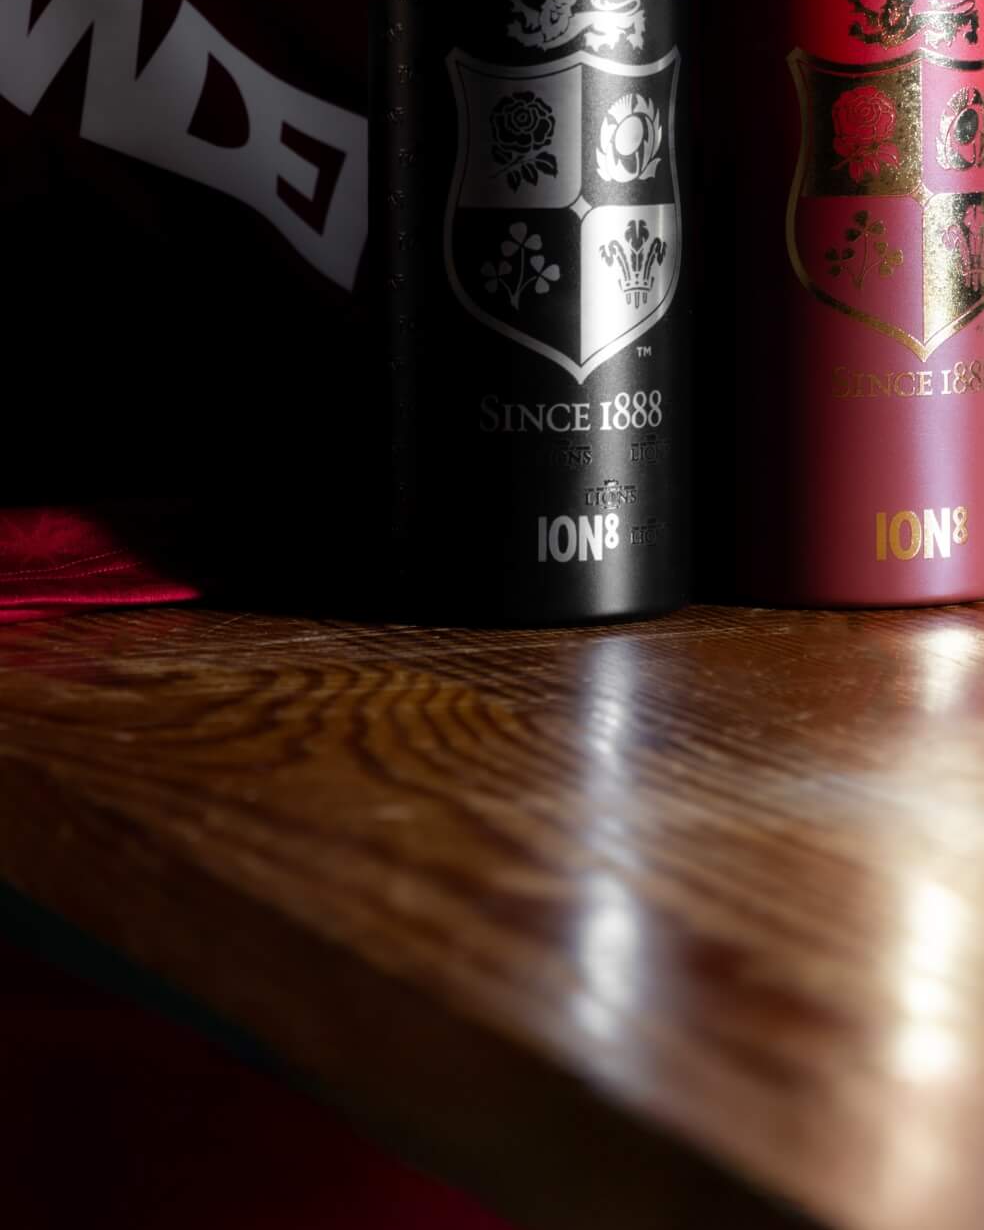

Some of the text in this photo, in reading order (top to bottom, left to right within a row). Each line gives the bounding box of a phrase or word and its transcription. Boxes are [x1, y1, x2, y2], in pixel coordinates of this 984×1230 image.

[479, 389, 663, 433] SINCE 1888
[537, 513, 620, 563] ION8
[876, 506, 969, 561] ION8
